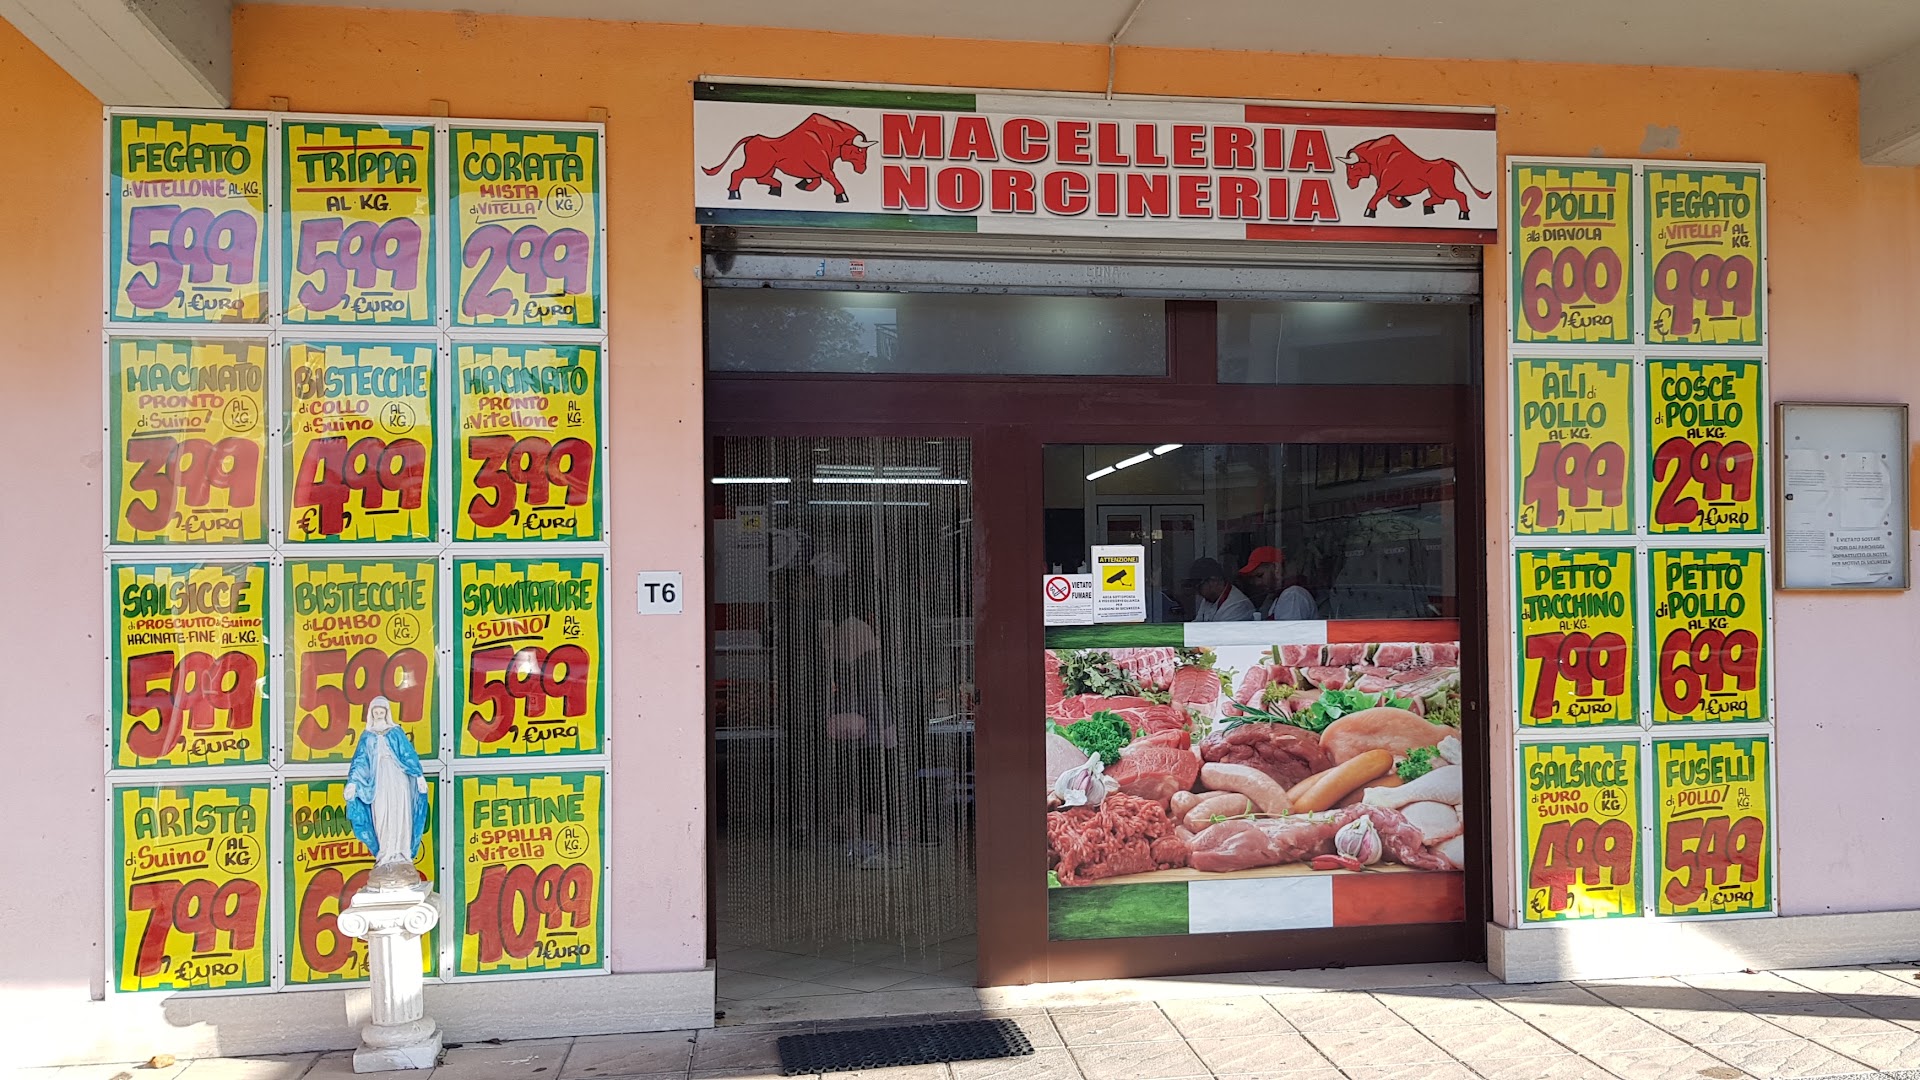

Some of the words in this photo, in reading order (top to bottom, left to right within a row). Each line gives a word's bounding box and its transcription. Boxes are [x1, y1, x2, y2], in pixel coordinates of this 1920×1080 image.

[881, 113, 1334, 172] MACELLERIA
[127, 141, 251, 175] FEGATO
[463, 151, 584, 182] CORATA
[297, 151, 417, 184] TRIPPA
[122, 185, 132, 197] di
[132, 179, 227, 198] VITELLONE
[229, 183, 241, 195] AL
[555, 187, 572, 198] AL
[881, 164, 1340, 222] NORCINERIA
[327, 196, 351, 212] AL
[469, 205, 479, 214] di
[478, 202, 535, 215] VITELLA
[1520, 186, 1543, 229] 2
[1545, 191, 1614, 221] POLLI
[1655, 190, 1751, 219] FEGATO
[1543, 227, 1602, 242] DIAVOLA
[1658, 228, 1667, 240] di
[1666, 223, 1722, 240] VITELLA
[1732, 223, 1748, 234] AL
[1653, 308, 1672, 336] €
[294, 365, 427, 400] BISTECCHE
[1542, 372, 1586, 400] ALI
[1586, 385, 1597, 399] di
[1661, 375, 1736, 402] COSCE
[138, 393, 224, 409] PRONTO
[233, 400, 248, 412] AL
[298, 403, 310, 414] di
[310, 399, 370, 416] COLLO
[391, 403, 405, 414] AL
[478, 396, 549, 411] PRONTO
[568, 400, 580, 411] AL
[137, 414, 148, 427] di
[149, 412, 202, 429] Suino
[463, 417, 473, 429] di
[469, 411, 559, 430] Vitellone
[1524, 401, 1606, 430] POLLO
[1654, 411, 1664, 425] di
[1665, 401, 1743, 428] POLLO
[302, 421, 312, 433] di
[312, 417, 374, 434] Suino
[1687, 428, 1705, 438] AL
[1548, 430, 1567, 440] AL
[296, 507, 317, 534] €
[1520, 505, 1535, 528] €
[1071, 581, 1092, 589] VIETATO
[1534, 564, 1612, 590] PETTO
[1666, 562, 1743, 591] PETTO
[123, 581, 251, 618] SALSICCE
[295, 579, 427, 615] BISTECCHE
[463, 579, 592, 616] SPUNTATURE
[644, 583, 676, 603] T6
[1521, 609, 1530, 620] di
[1523, 591, 1625, 622] TACCHINO
[1655, 601, 1668, 618] di
[1667, 591, 1746, 620] POLLO
[128, 621, 136, 631] di
[136, 617, 216, 630] PROSCIUTTO
[221, 616, 261, 629] Suino
[302, 620, 312, 631] di
[394, 617, 409, 628] AL
[465, 624, 475, 639] di
[477, 617, 544, 639] SUINO
[564, 616, 579, 625] AL
[1559, 621, 1571, 630] AL
[1688, 619, 1705, 630] AL
[222, 635, 235, 645] AL
[307, 635, 317, 648] di
[317, 631, 377, 649] Suino
[1529, 759, 1629, 791] SALSICCE
[1666, 755, 1755, 788] FUSELLI
[1531, 794, 1539, 803] di
[1540, 789, 1581, 804] PURO
[1601, 790, 1618, 799] AL
[1666, 795, 1675, 806] di
[1678, 789, 1721, 807] POLLO
[1738, 787, 1750, 797] AL
[473, 793, 585, 830] FETTINE
[1537, 802, 1589, 818] SUINO
[134, 804, 257, 840] ARISTA
[469, 832, 479, 844] di
[481, 826, 553, 845] SPALLA
[565, 829, 579, 839] AL
[226, 838, 249, 850] AL
[468, 854, 478, 863] di
[477, 842, 545, 862] Vitella
[125, 851, 137, 866] di
[138, 845, 206, 870] Suino
[297, 849, 307, 862] di
[1530, 888, 1546, 913] €
